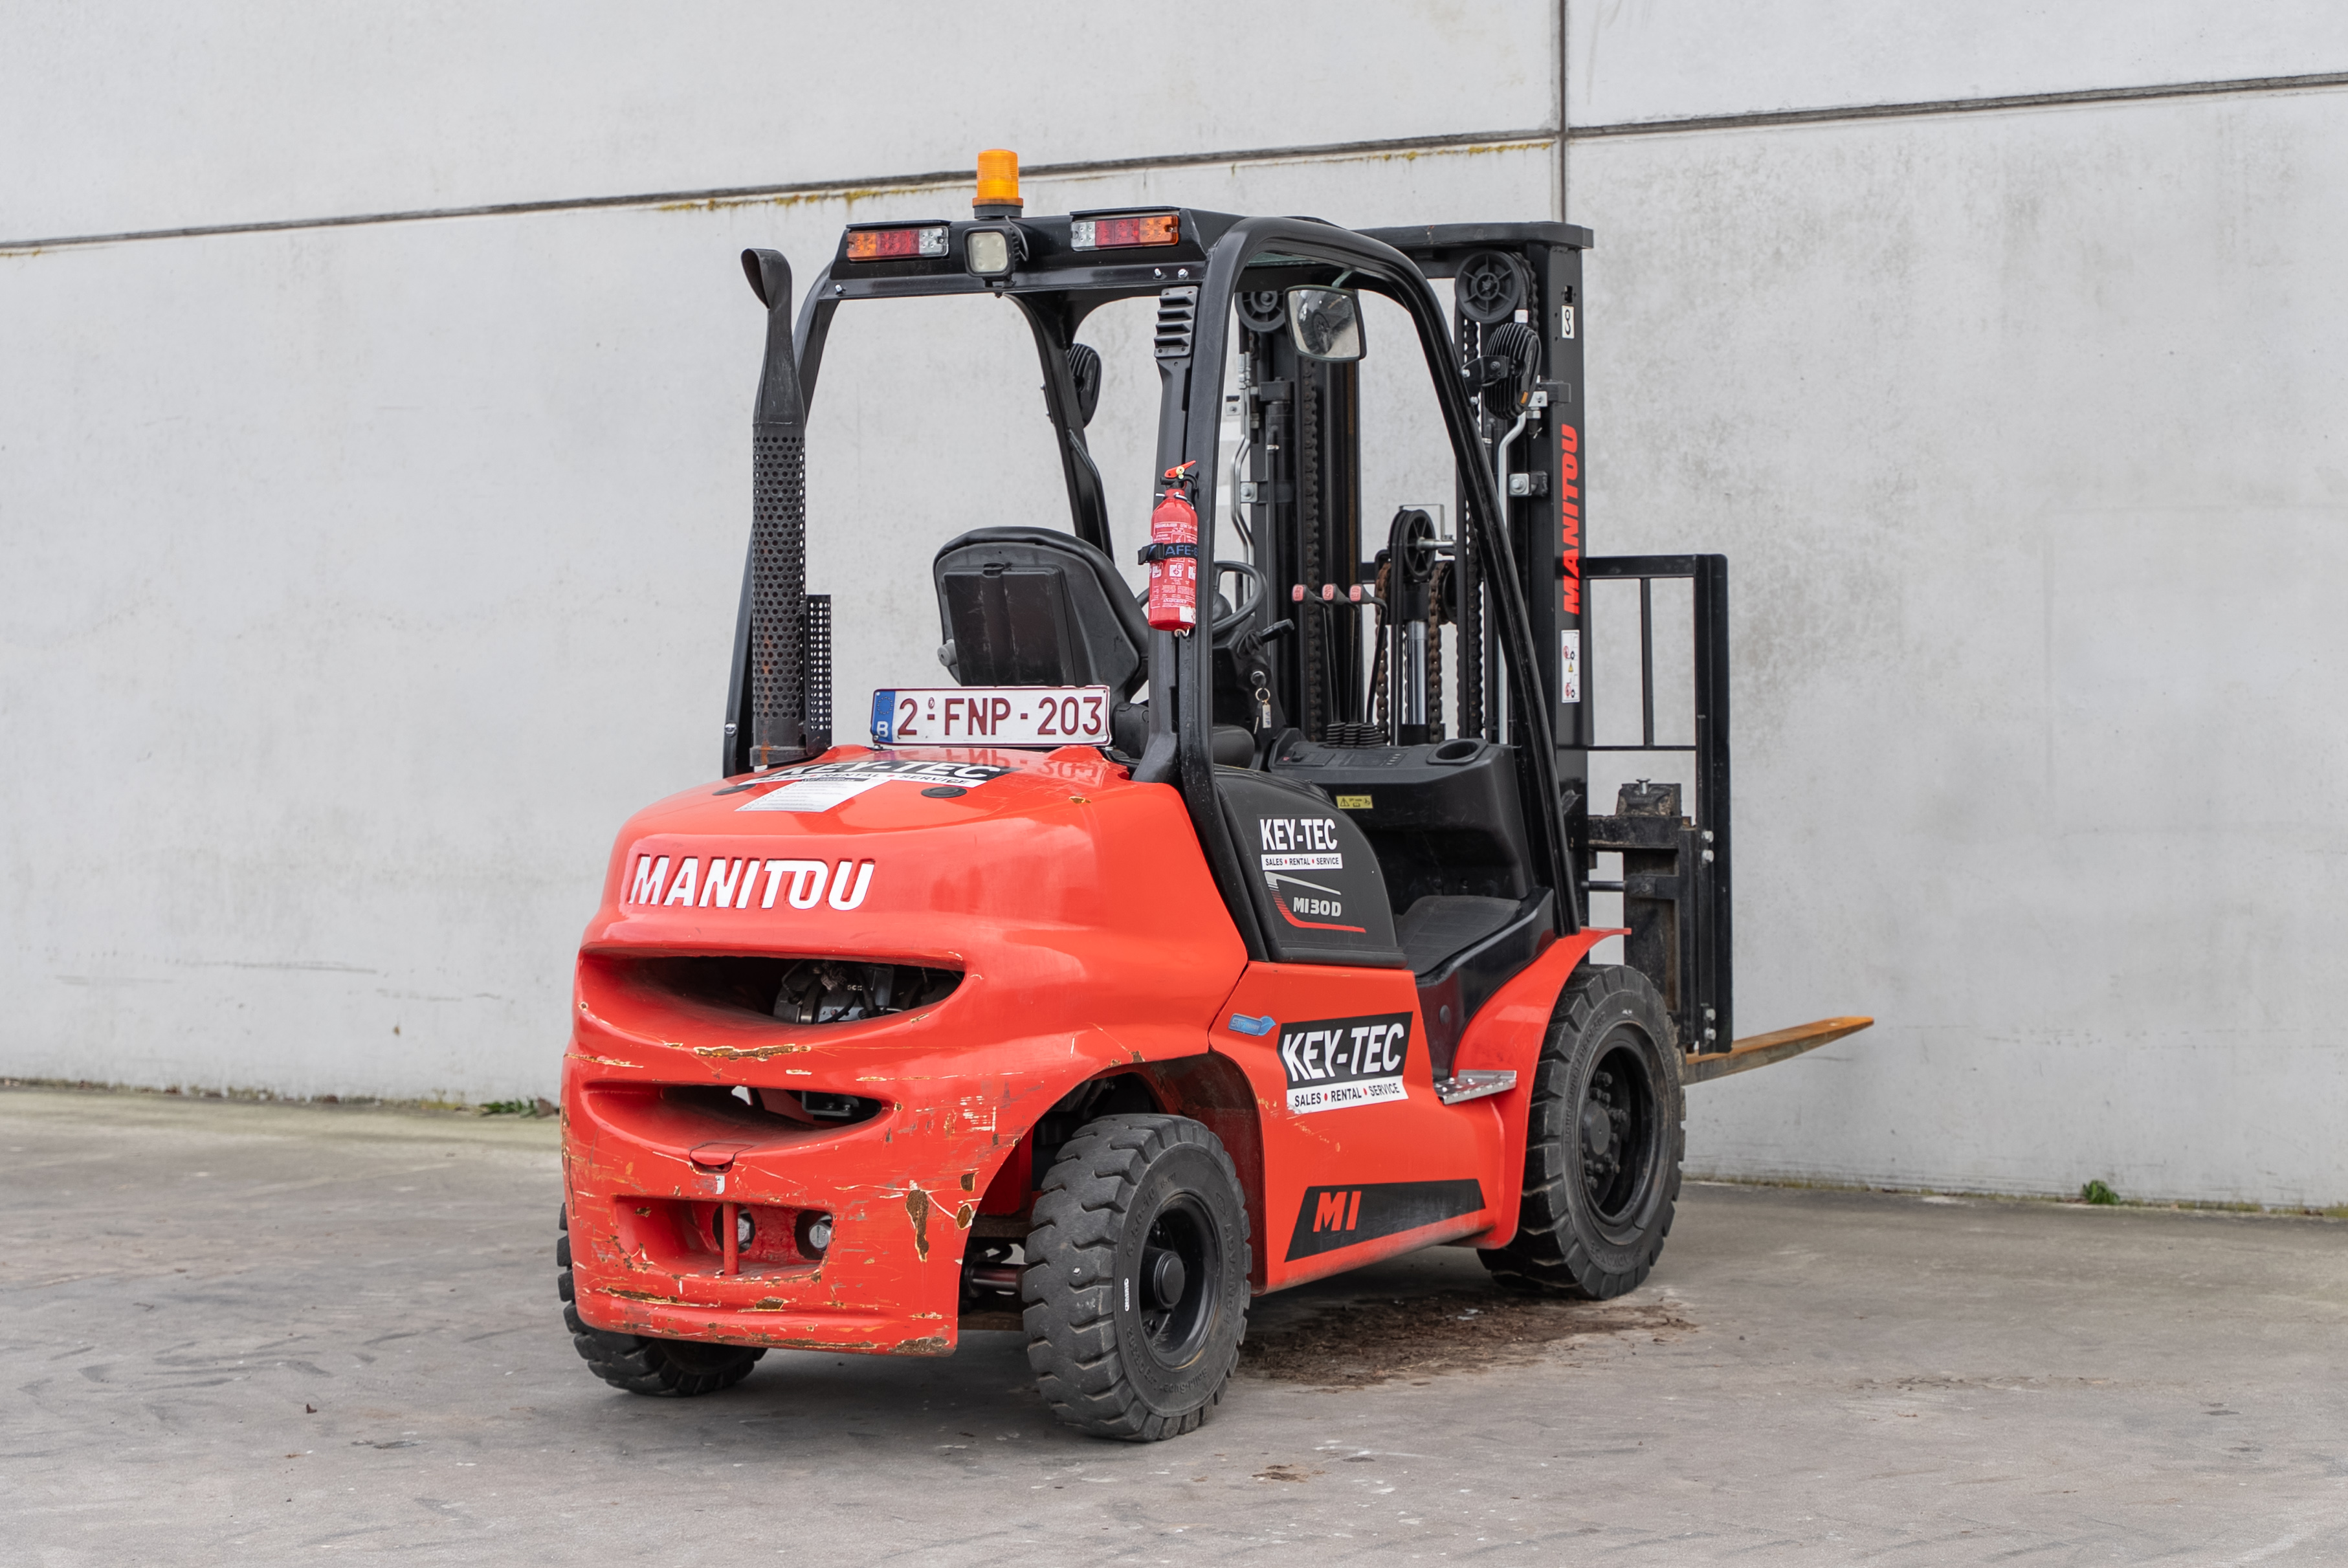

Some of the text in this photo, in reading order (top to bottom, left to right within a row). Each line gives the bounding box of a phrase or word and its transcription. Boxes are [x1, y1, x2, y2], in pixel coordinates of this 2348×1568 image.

[1561, 423, 1580, 615] MANITOU
[877, 720, 889, 737] B
[770, 760, 1001, 778] KEY-TEC
[899, 774, 971, 784] SERVICE
[1259, 819, 1338, 850] KEY-TEC
[628, 854, 875, 911] MANITOU
[1293, 897, 1342, 917] MI30D
[1282, 1022, 1404, 1082] KEY-TEC
[1294, 1083, 1401, 1107] SALES RENTAL SERVICE
[1313, 1190, 1362, 1232] MI
